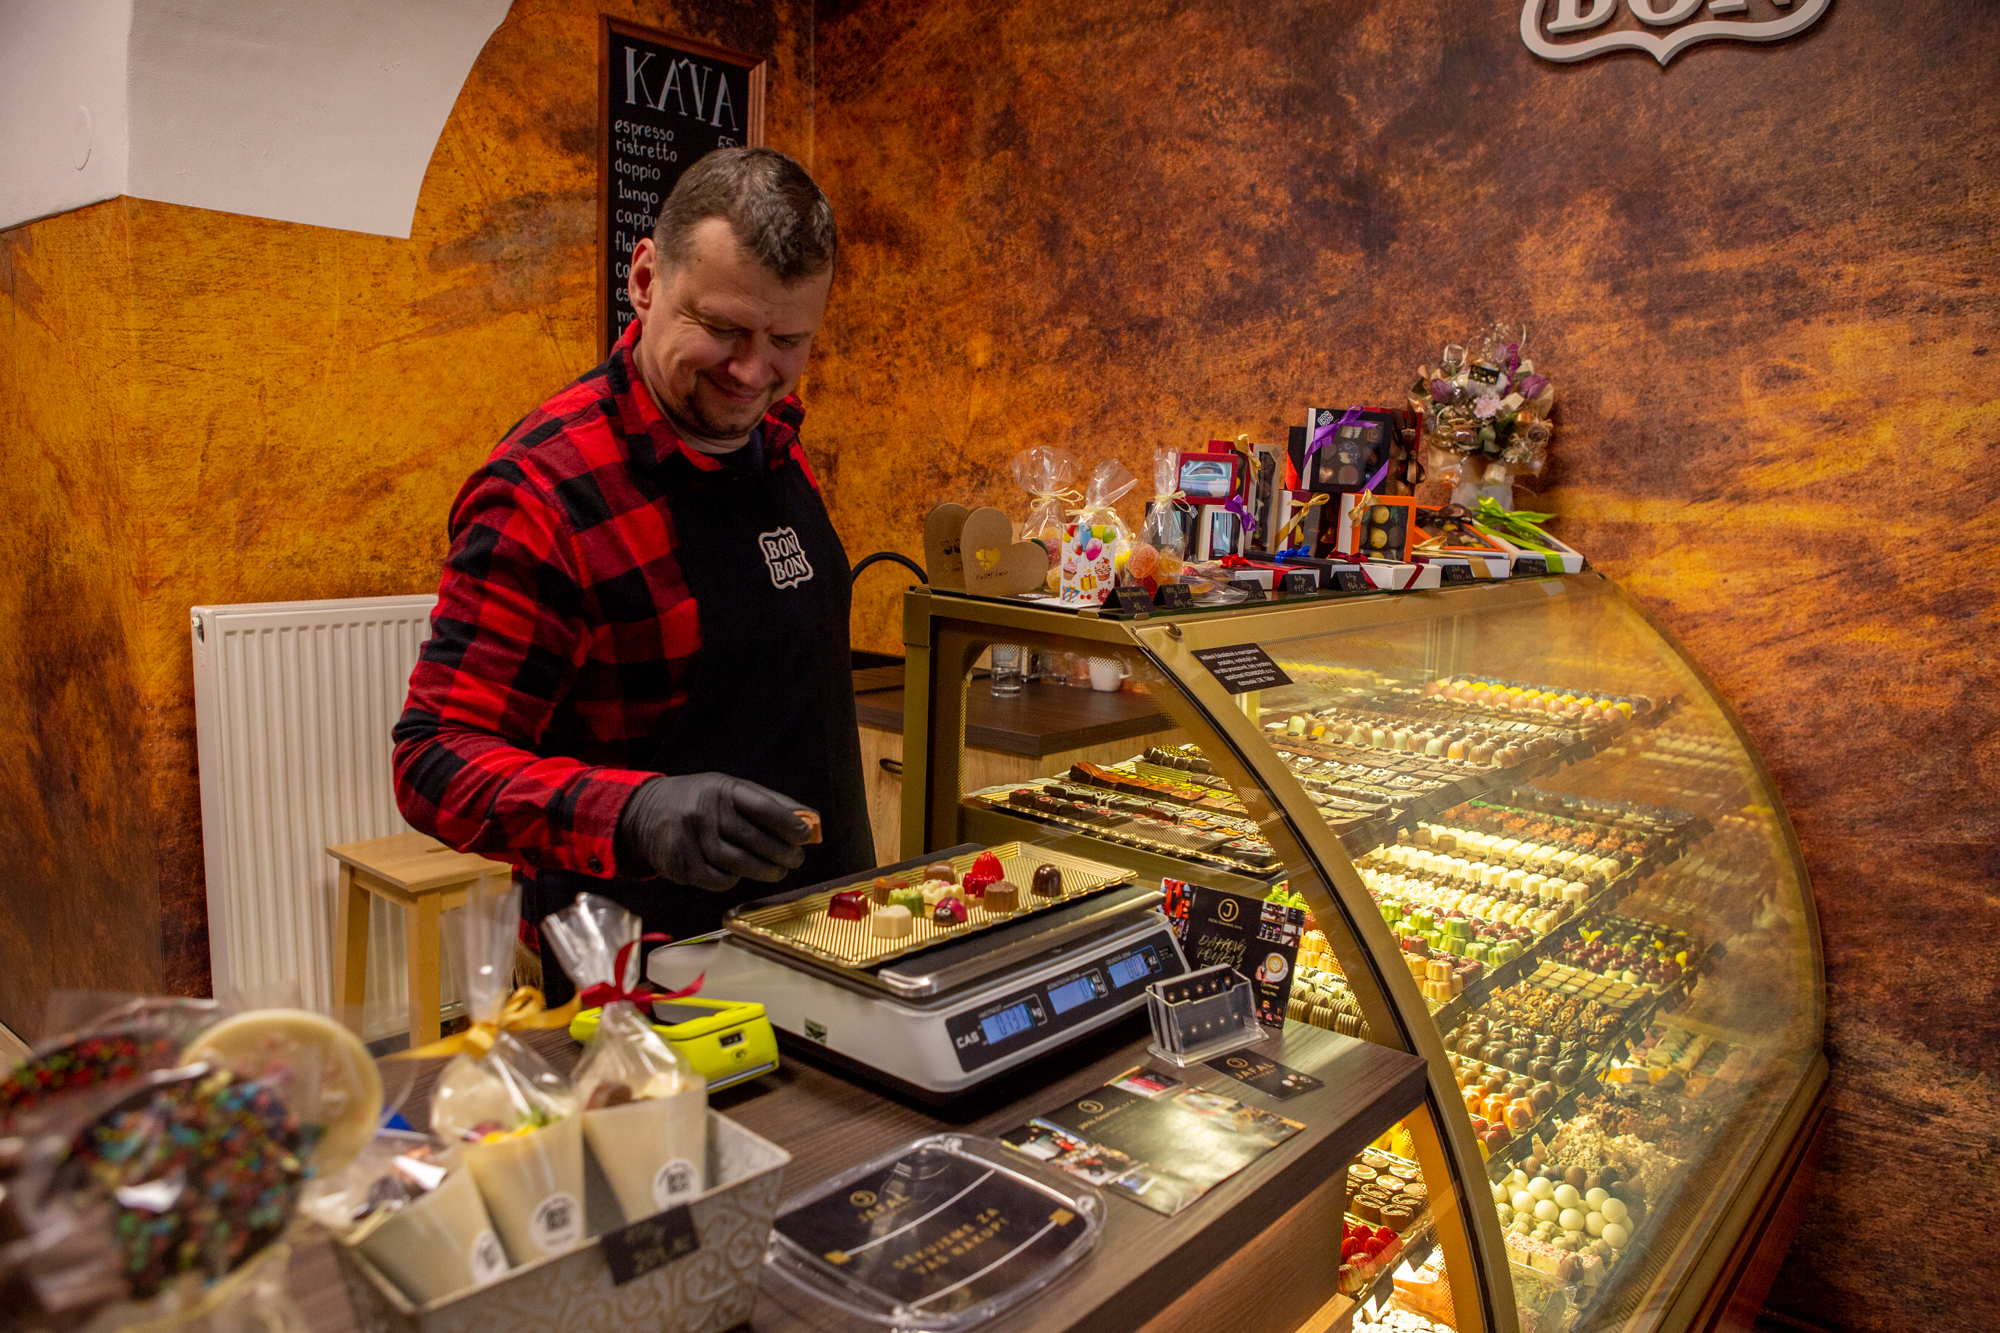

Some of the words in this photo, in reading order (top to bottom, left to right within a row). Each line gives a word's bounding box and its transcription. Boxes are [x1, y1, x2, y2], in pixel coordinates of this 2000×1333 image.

[624, 46, 739, 131] KÁVA
[614, 118, 674, 142] espresso
[615, 139, 678, 163] ristretto
[615, 158, 661, 182] doppio
[618, 180, 659, 214] lungo
[616, 287, 632, 304] es
[764, 535, 798, 560] BON
[772, 555, 807, 581] BON
[1302, 668, 1350, 692] Fresh
[1032, 1007, 1043, 1018] kg
[955, 1031, 980, 1049] CAS
[1234, 1062, 1275, 1080] JAFAL
[858, 1194, 911, 1224] JAFAL
